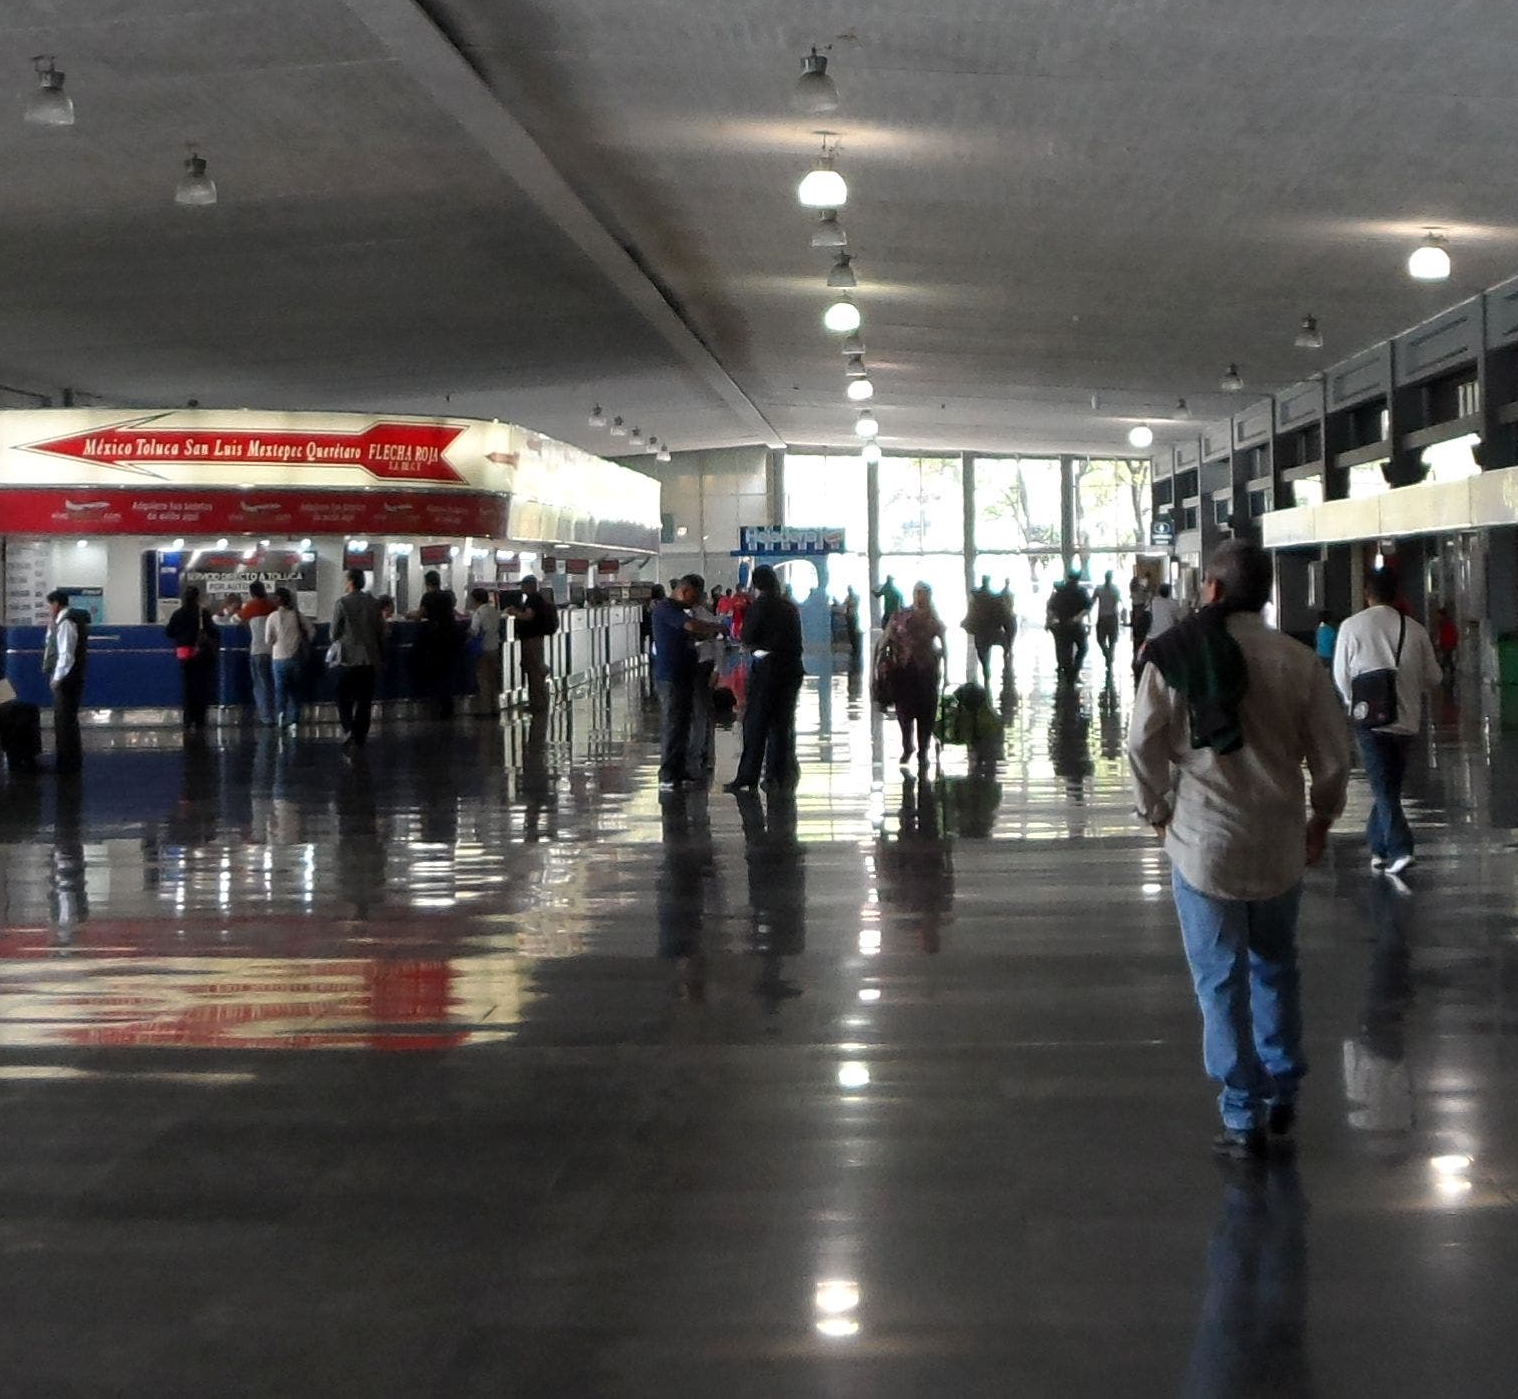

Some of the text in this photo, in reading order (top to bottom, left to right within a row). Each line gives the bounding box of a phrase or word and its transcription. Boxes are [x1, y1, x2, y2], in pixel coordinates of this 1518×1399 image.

[83, 438, 361, 461] México Toluca San Luis Mextepec Querétaro
[368, 443, 439, 465] FLECHA ROJA
[266, 572, 303, 581] TOLUCA
